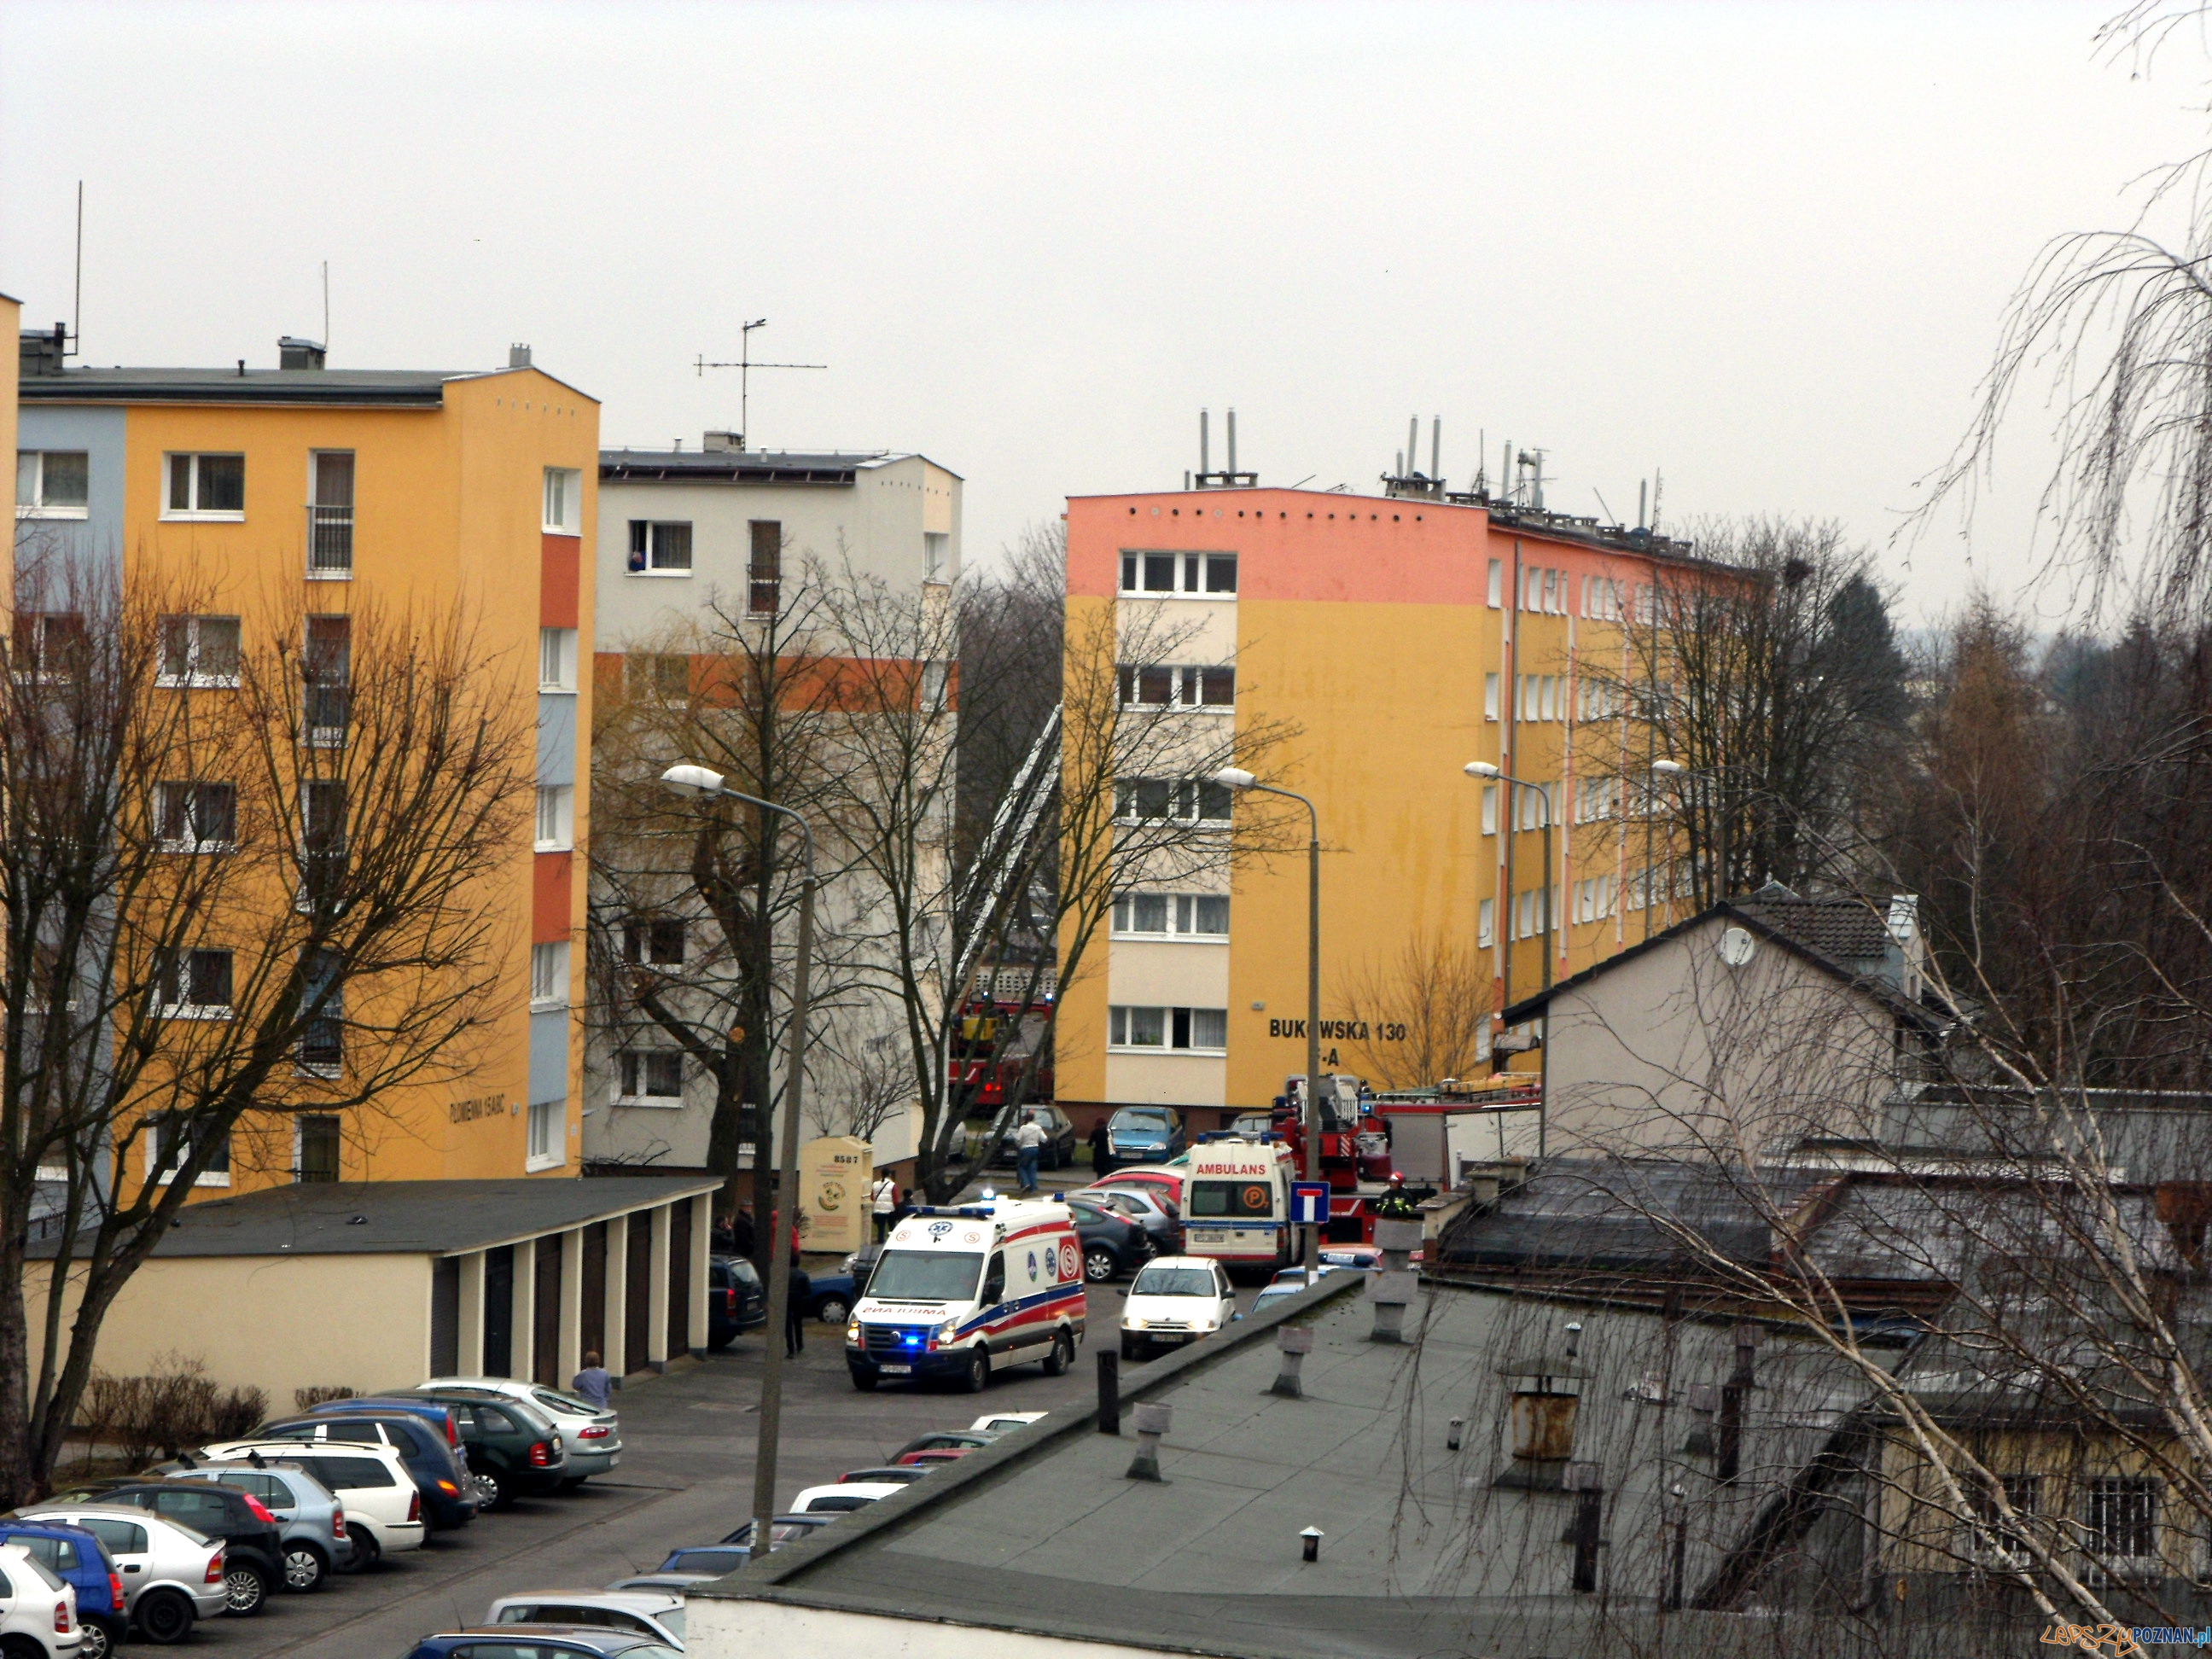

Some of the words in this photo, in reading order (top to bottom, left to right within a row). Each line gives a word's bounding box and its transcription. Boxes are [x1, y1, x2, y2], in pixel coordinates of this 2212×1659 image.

[1270, 1019, 1370, 1039] BUKWSKA
[1377, 1022, 1406, 1041] 130
[834, 1155, 859, 1164] 8587
[1196, 1163, 1266, 1175] AMBULANS
